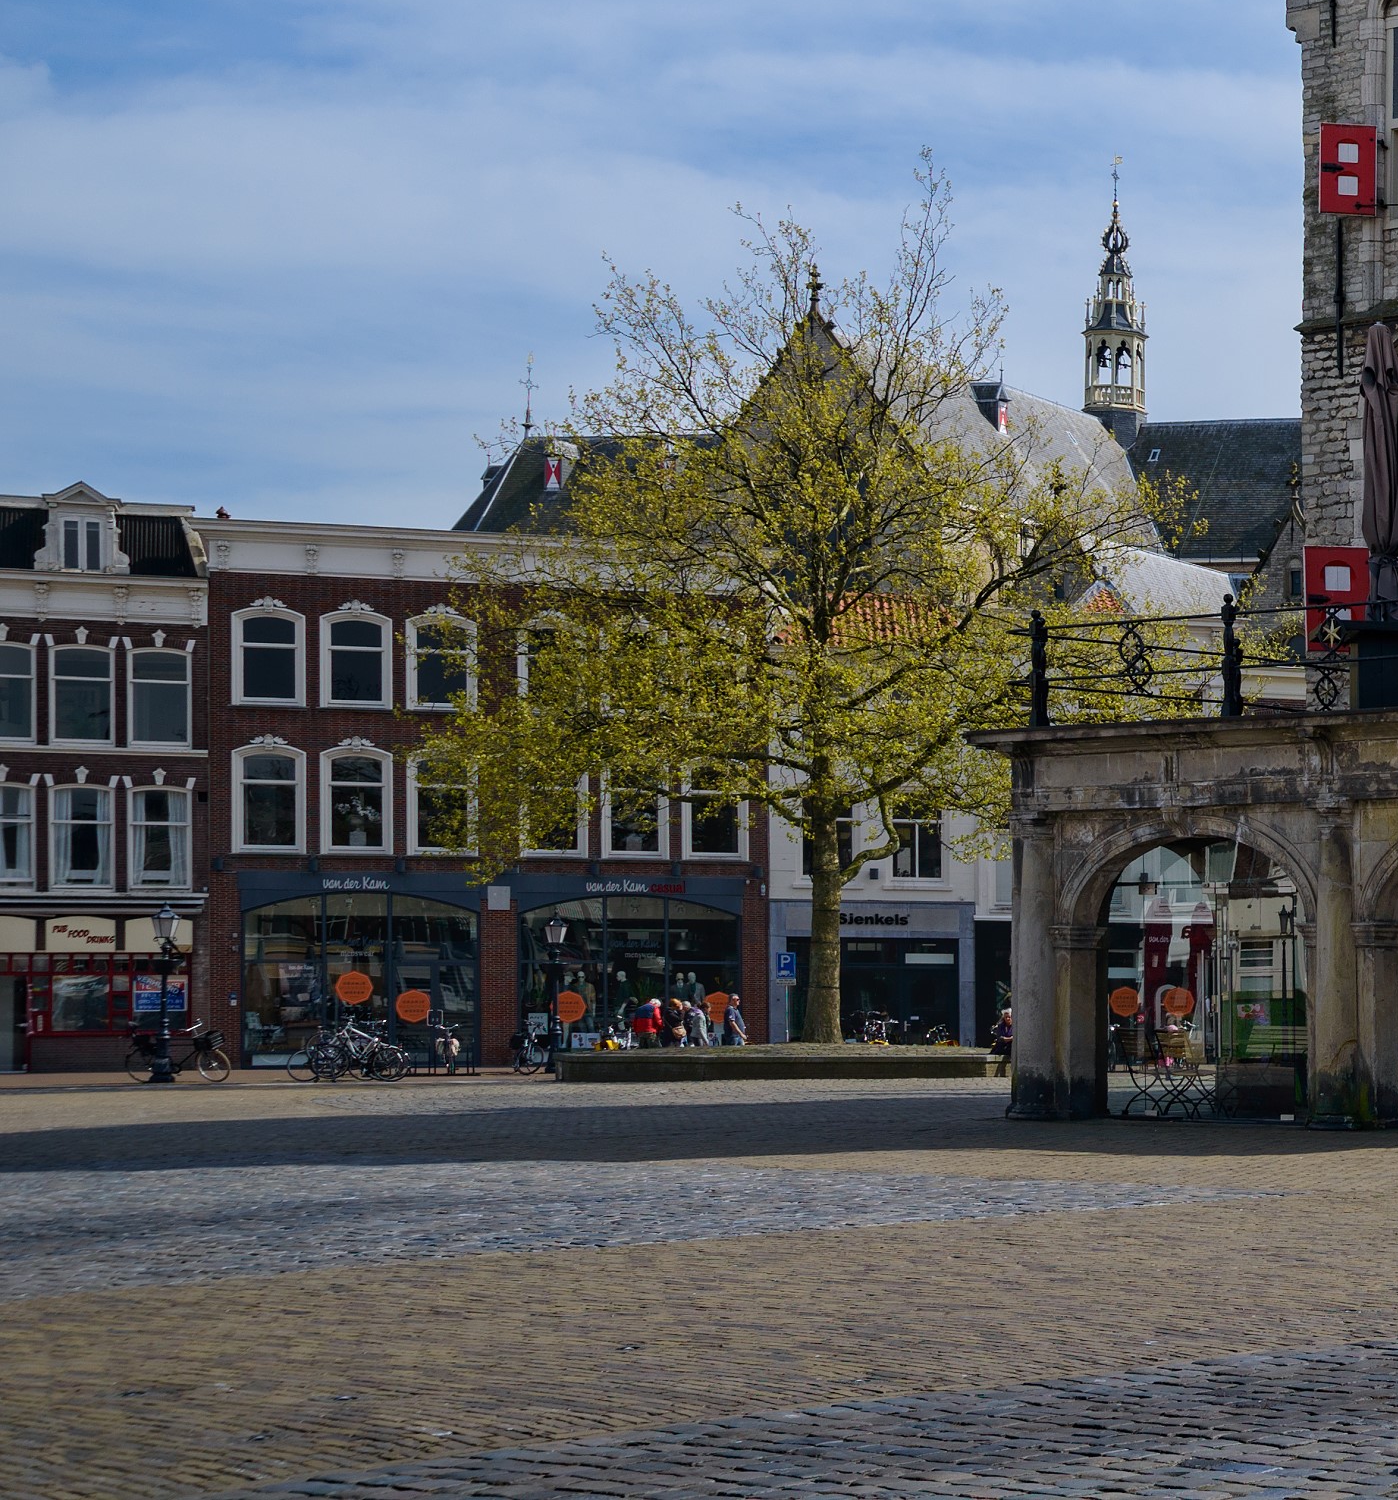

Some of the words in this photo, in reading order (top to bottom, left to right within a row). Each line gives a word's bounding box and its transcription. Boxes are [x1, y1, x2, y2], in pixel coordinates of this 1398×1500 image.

[322, 879, 343, 889] van
[344, 878, 361, 889] der
[362, 876, 390, 890] Kam
[586, 882, 605, 892] van
[606, 881, 622, 892] der
[623, 879, 648, 892] Kam
[650, 880, 686, 893] casual
[52, 925, 68, 933] PUB
[68, 930, 90, 938] FOOD
[780, 955, 791, 968] P
[136, 975, 179, 994] VERHURD
